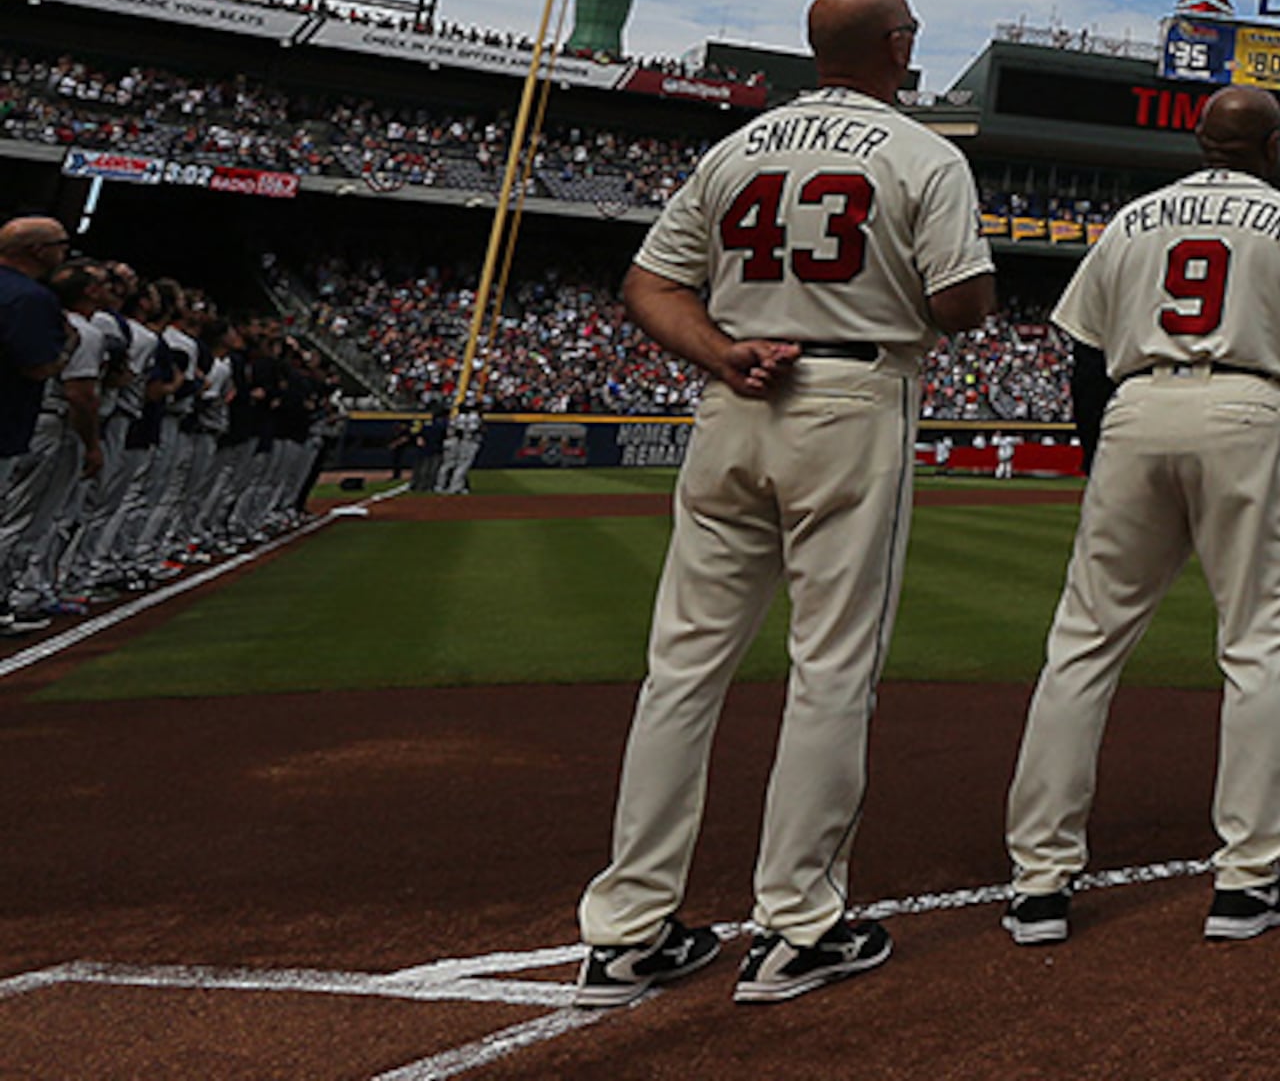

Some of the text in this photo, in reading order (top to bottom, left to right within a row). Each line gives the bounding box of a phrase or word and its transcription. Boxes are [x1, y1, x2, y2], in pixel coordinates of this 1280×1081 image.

[176, 3, 213, 18] YOUR
[220, 9, 265, 27] SEATS
[362, 32, 406, 49] CHECK
[745, 116, 889, 159] SNITKER
[720, 171, 876, 284] 43
[1158, 238, 1232, 336] 9
